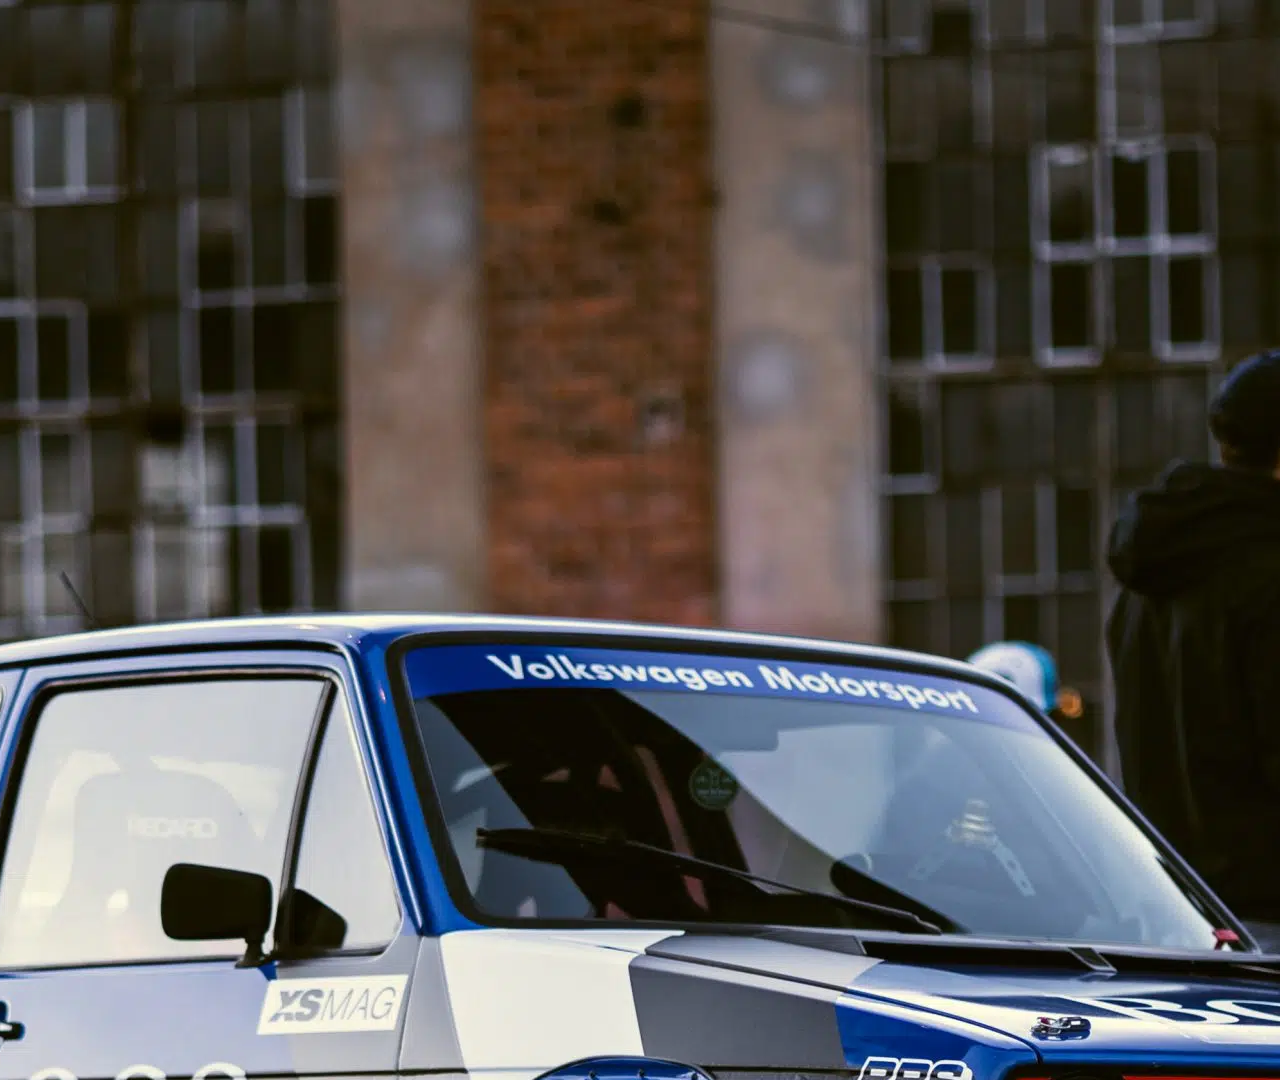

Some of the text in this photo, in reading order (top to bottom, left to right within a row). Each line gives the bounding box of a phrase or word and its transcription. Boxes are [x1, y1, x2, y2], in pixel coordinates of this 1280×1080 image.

[486, 653, 979, 714] Volkswagen Motorsport
[127, 816, 218, 839] RECARO
